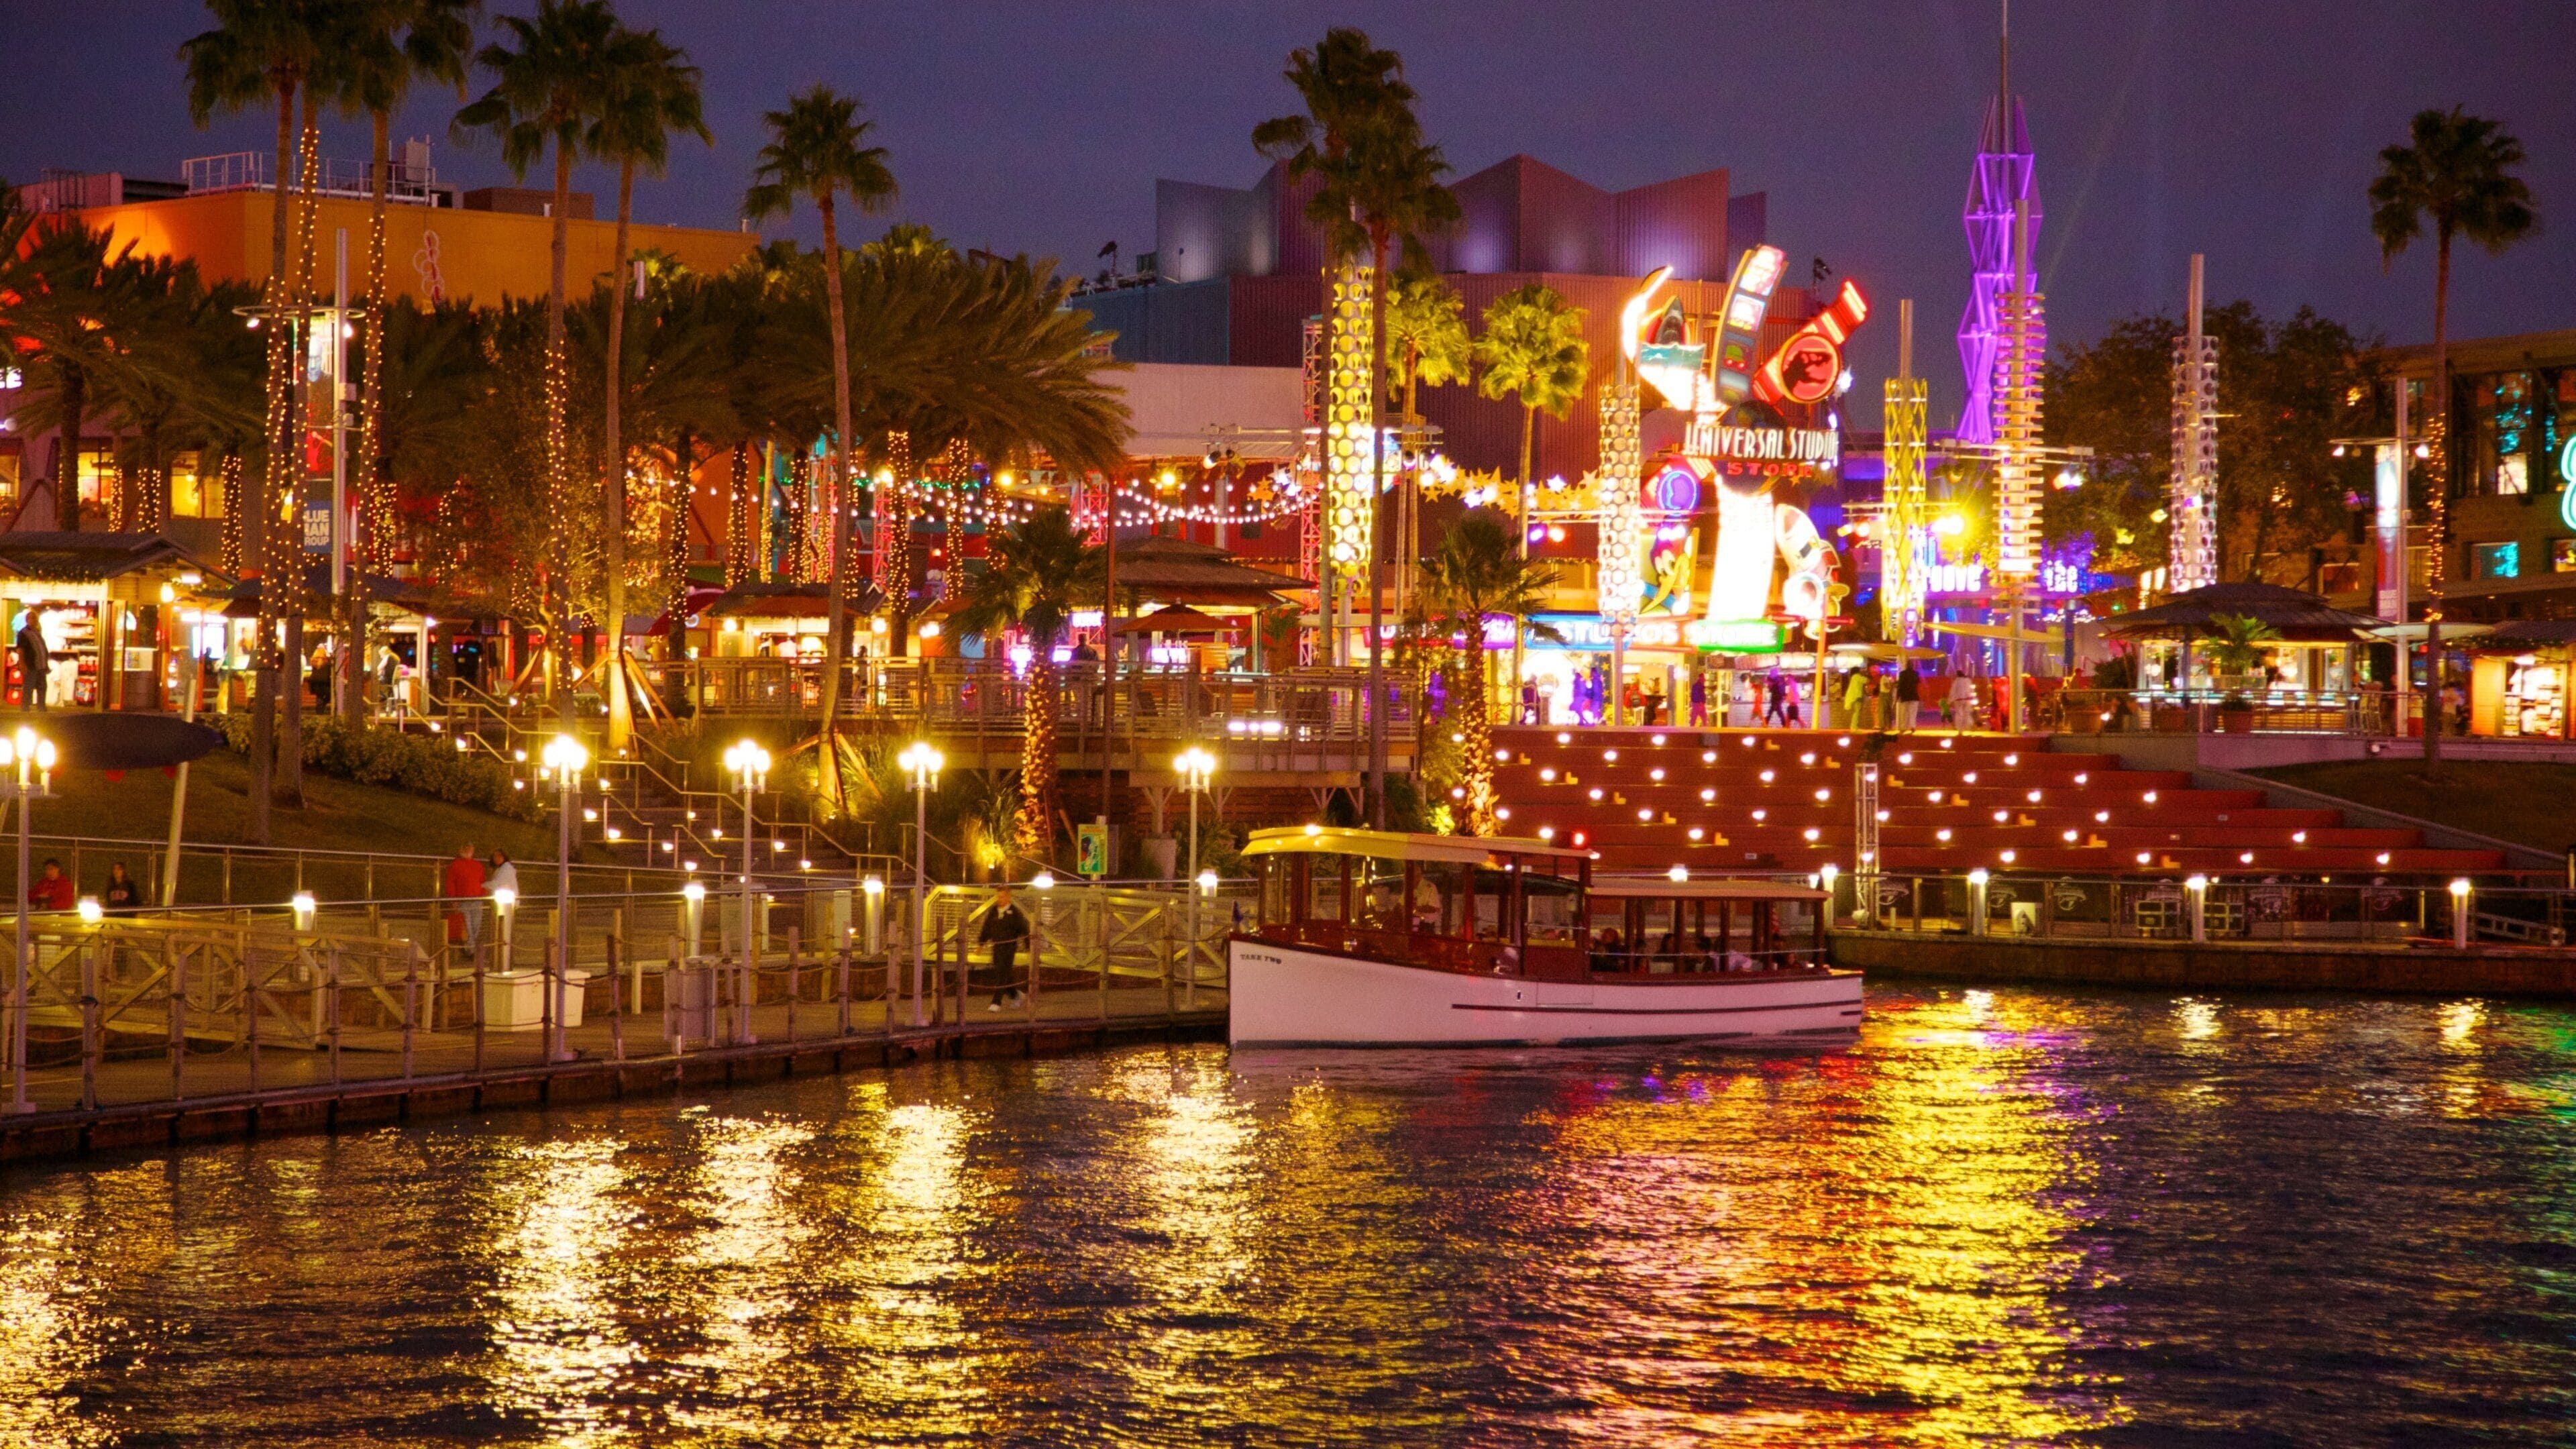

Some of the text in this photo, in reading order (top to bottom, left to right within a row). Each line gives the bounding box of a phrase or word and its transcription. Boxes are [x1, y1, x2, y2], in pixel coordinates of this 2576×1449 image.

[1682, 422, 1785, 459] UNIVERSAL
[1727, 462, 1812, 477] STORE
[304, 510, 329, 523] LUE
[304, 537, 329, 546] ROUP
